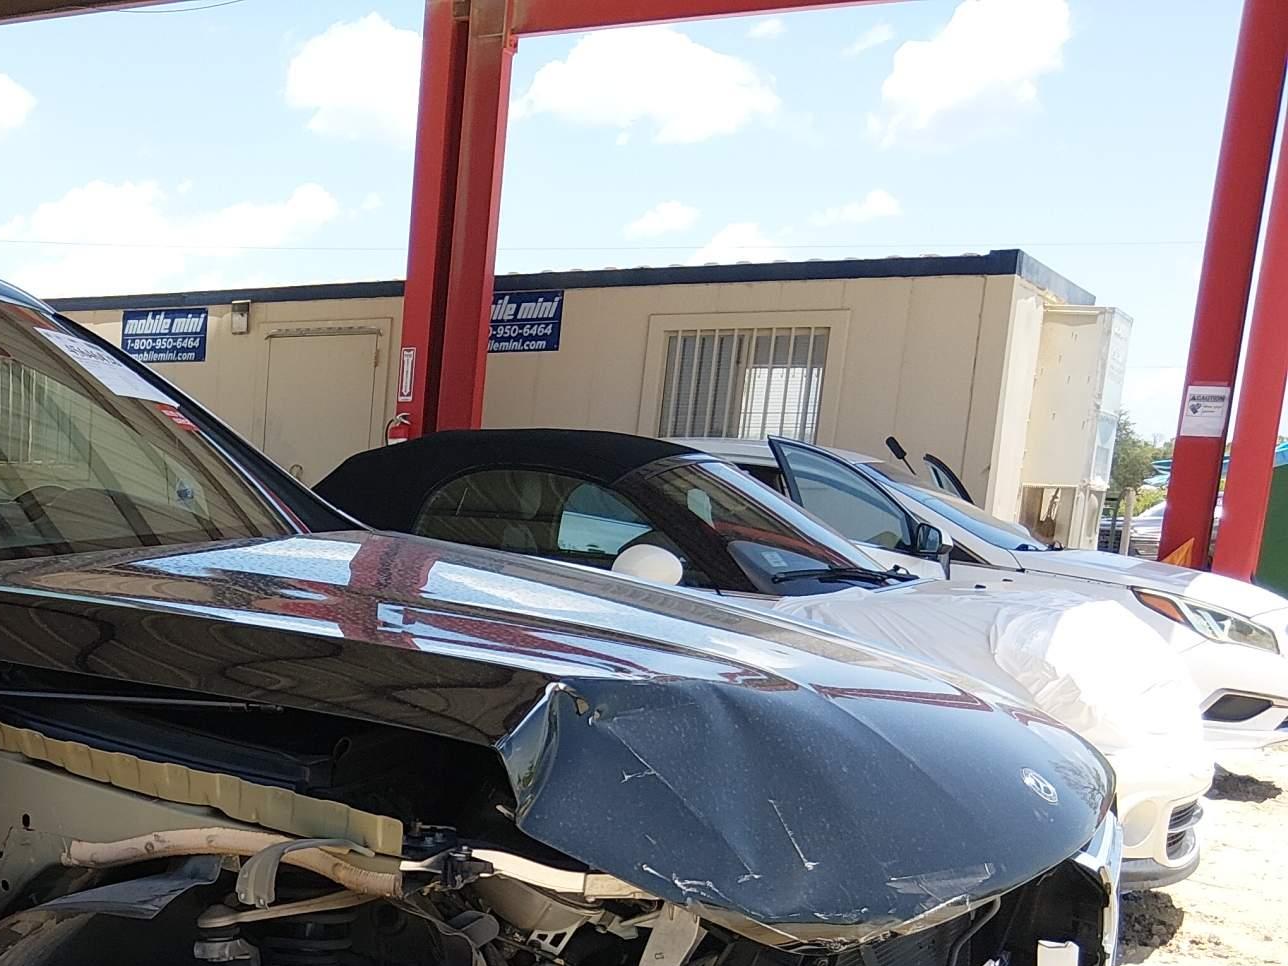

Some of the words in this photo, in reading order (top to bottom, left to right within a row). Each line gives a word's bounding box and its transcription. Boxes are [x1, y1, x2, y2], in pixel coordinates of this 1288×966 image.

[490, 295, 517, 320] ile
[516, 297, 560, 319] mini
[123, 312, 172, 334] mobile
[172, 313, 206, 333] mini
[489, 323, 553, 338] -950-6464
[126, 337, 200, 350] 1-800-950-6464
[488, 339, 547, 351] ilemini.com
